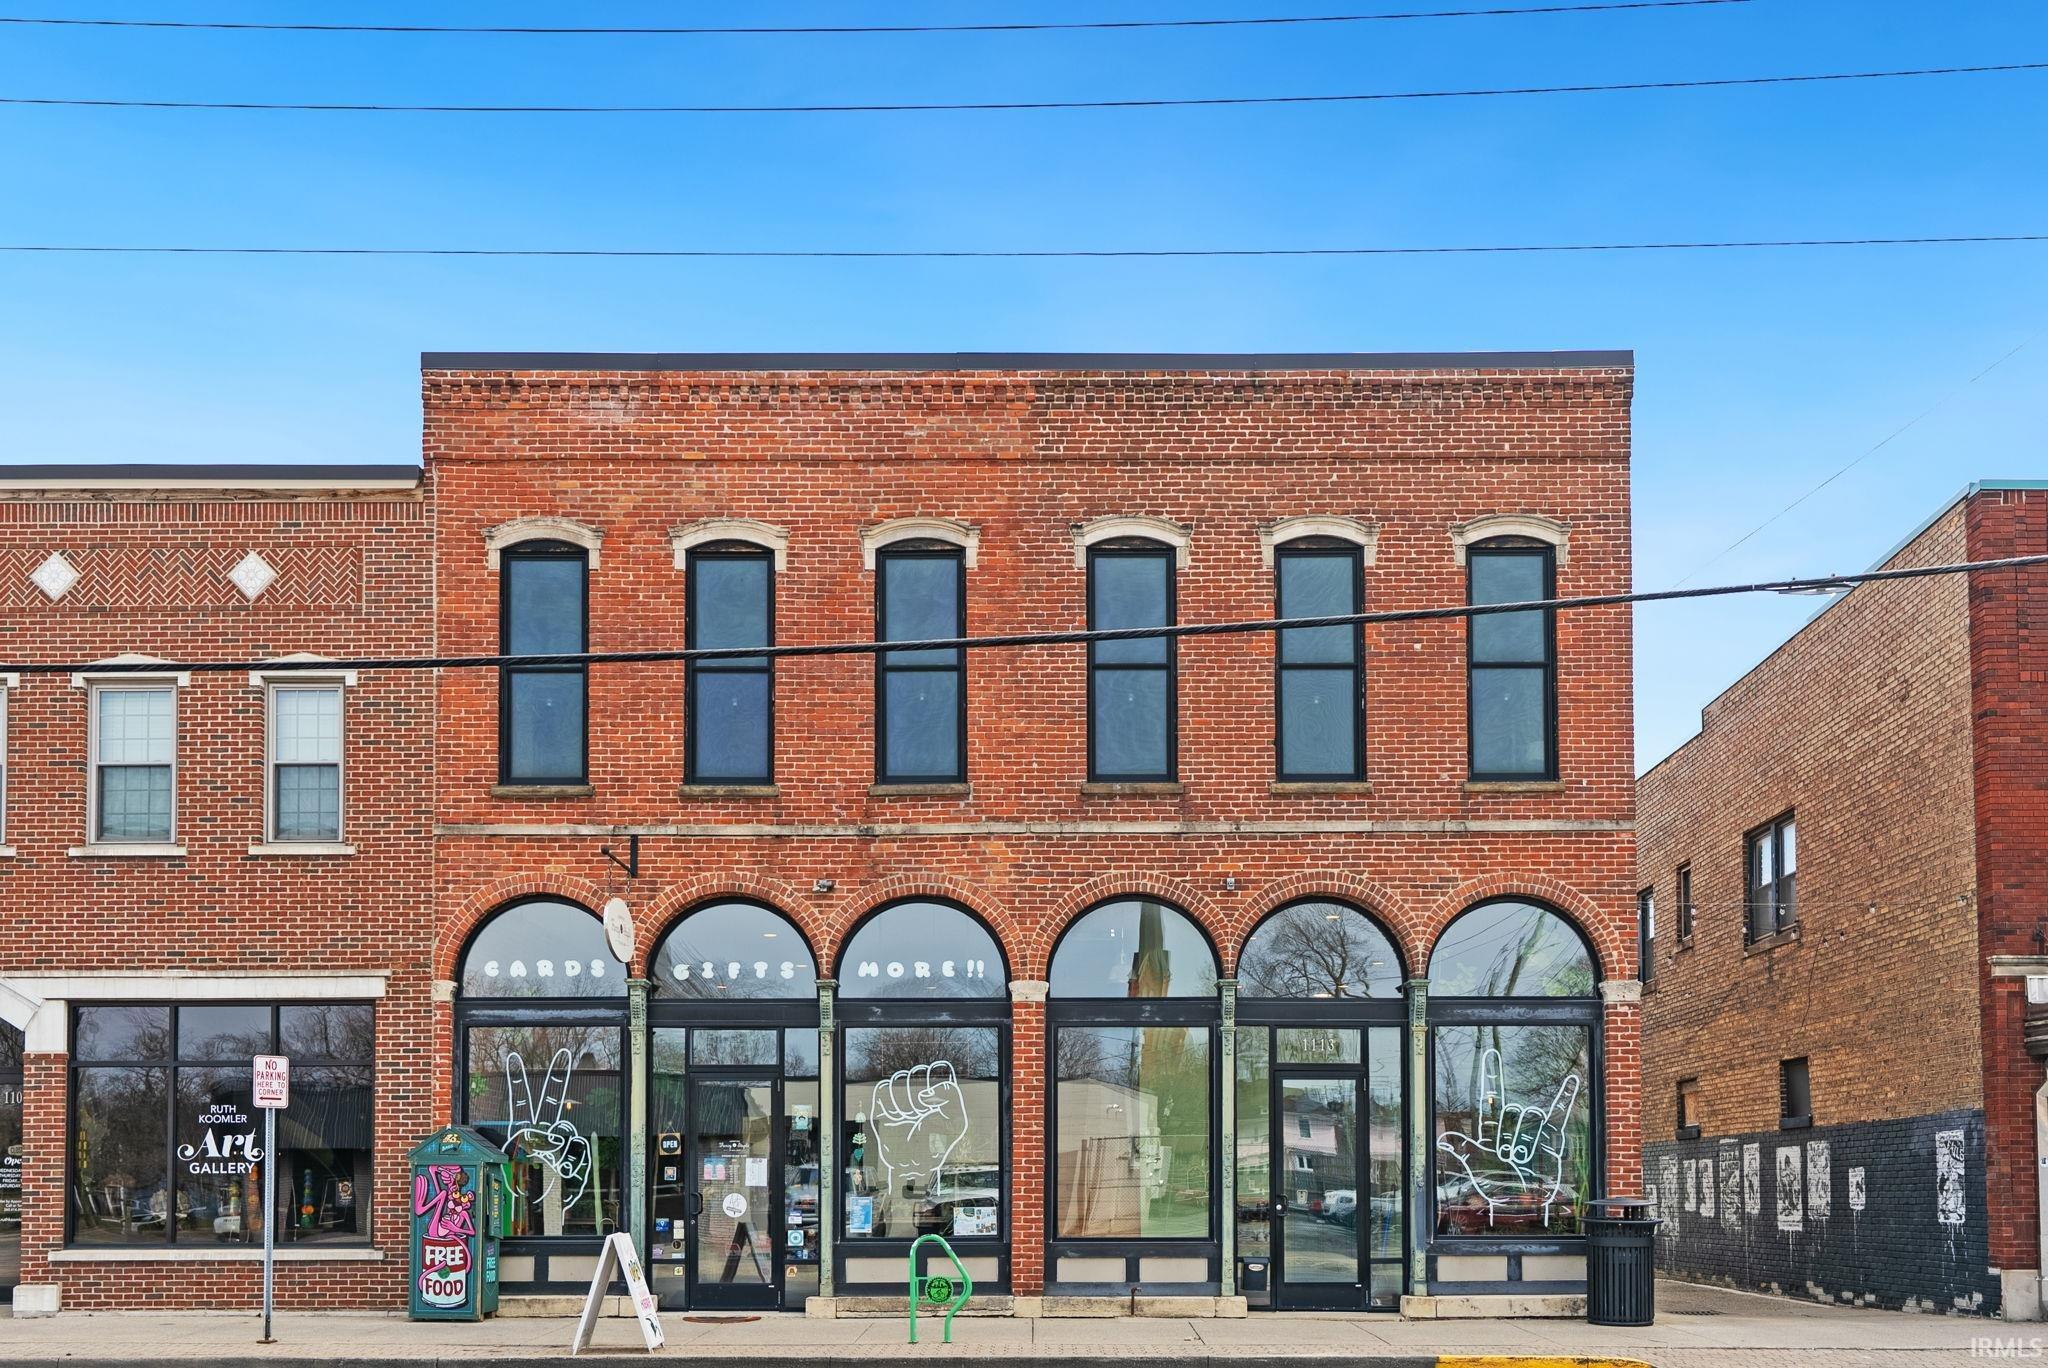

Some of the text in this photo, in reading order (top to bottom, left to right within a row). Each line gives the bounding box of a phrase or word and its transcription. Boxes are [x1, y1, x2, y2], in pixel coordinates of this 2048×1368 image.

[484, 958, 605, 978] CARDS
[672, 960, 795, 981] GIFTS
[857, 959, 985, 979] MORE!!
[1303, 1037, 1335, 1052] 1113
[265, 1060, 277, 1070] NO
[256, 1071, 286, 1081] PARKING
[258, 1088, 284, 1096] CORNER
[210, 1104, 236, 1114] RUTH
[198, 1114, 247, 1124] KOOMLER
[177, 1127, 265, 1162] Art
[662, 1140, 678, 1149] OPEN
[3, 1156, 22, 1166] Ope
[189, 1162, 256, 1174] GALLERY
[425, 1245, 464, 1266] FREE
[425, 1278, 464, 1296] FOOD
